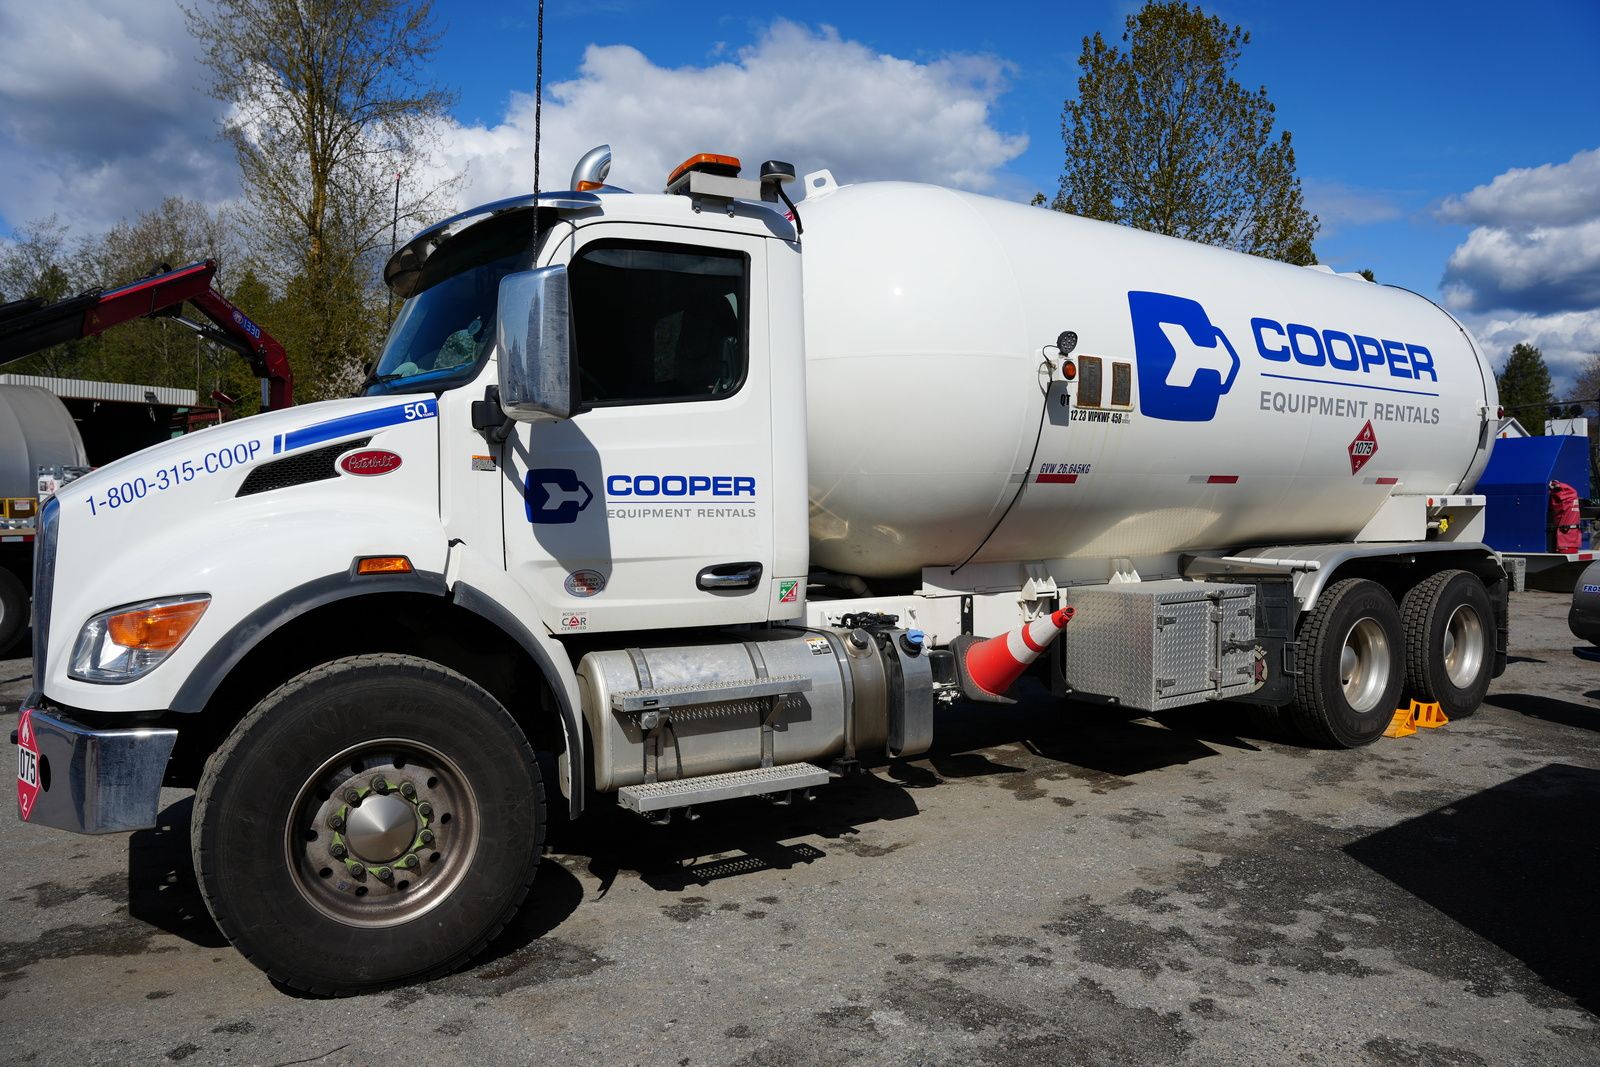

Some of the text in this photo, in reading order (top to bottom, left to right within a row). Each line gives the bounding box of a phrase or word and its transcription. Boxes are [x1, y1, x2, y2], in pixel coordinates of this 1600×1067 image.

[1251, 317, 1438, 382] COOPER
[1060, 394, 1071, 406] QT
[1260, 391, 1440, 425] EQUIPMENT RENTALS
[404, 402, 428, 420] 50
[1070, 410, 1078, 421] 12
[1079, 410, 1087, 422] 23
[1111, 413, 1122, 424] 458
[1354, 442, 1373, 454] 1075
[348, 455, 396, 471] Peterbilt
[1040, 463, 1057, 474] GVW
[1355, 460, 1361, 468] 2
[85, 439, 261, 516] 1-800-315-COOP
[607, 475, 756, 497] COOPER
[607, 508, 756, 519] EQUIPMENT RENTALS
[17, 748, 36, 784] 075
[22, 793, 28, 812] 2
